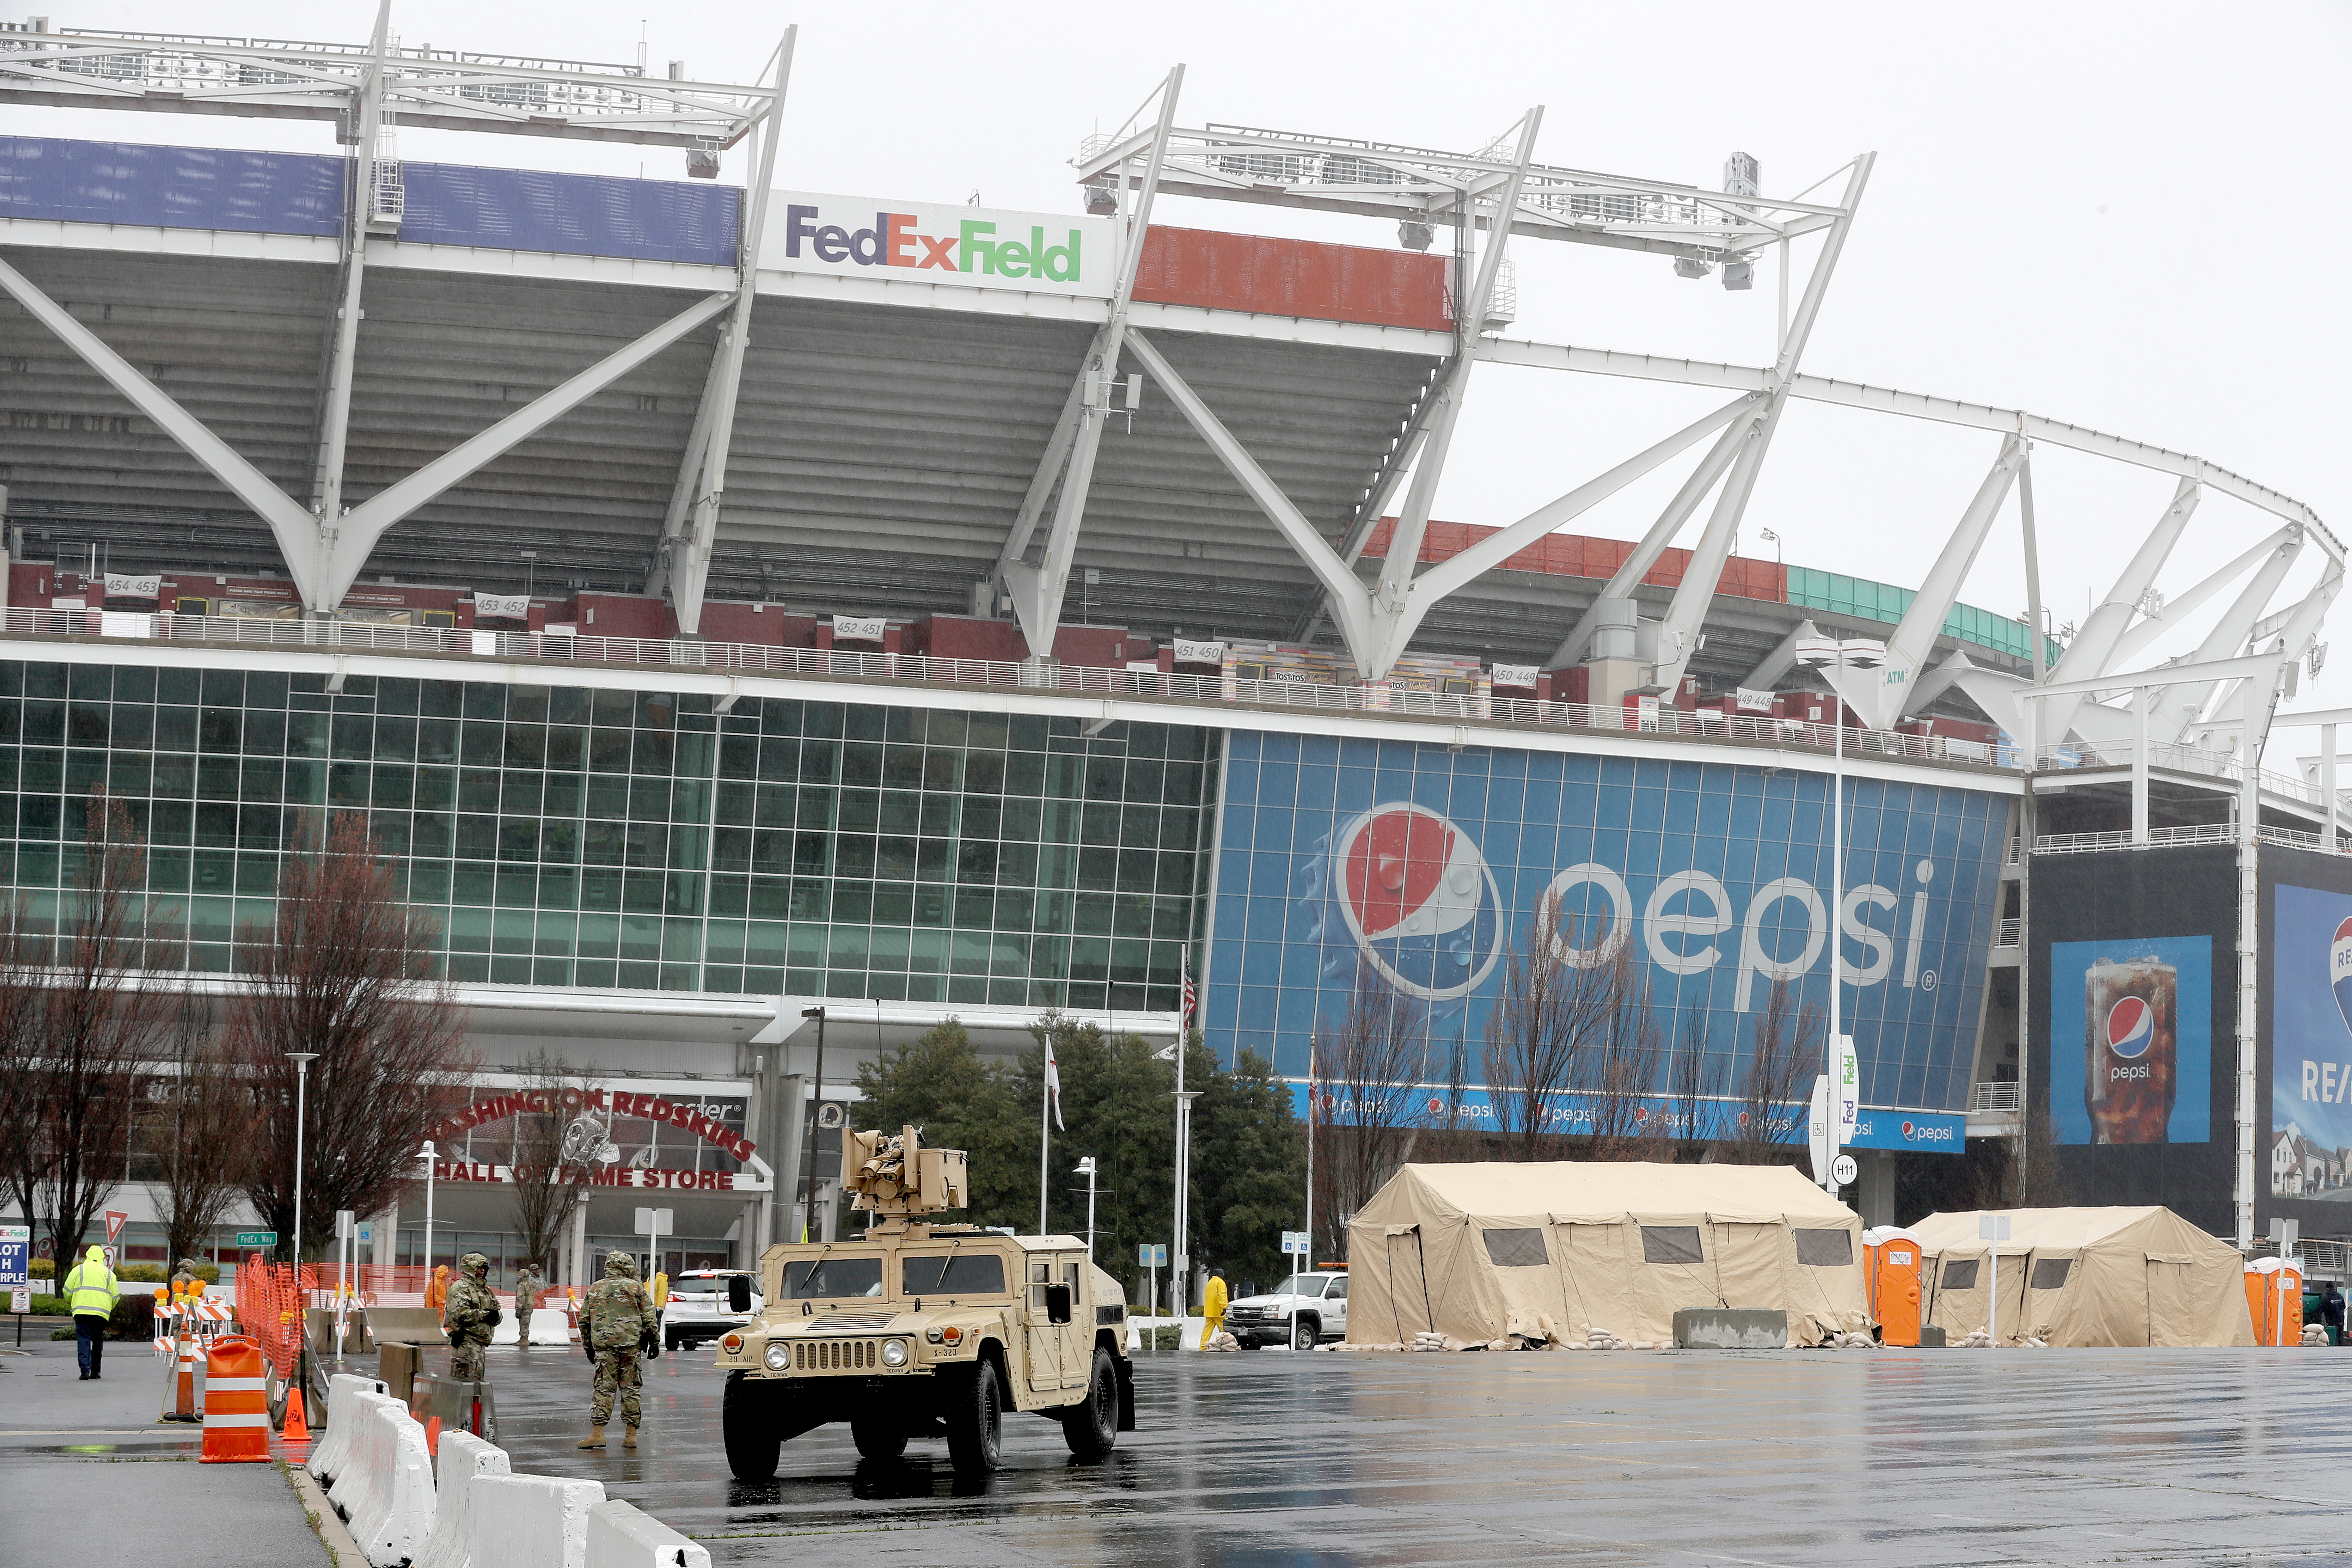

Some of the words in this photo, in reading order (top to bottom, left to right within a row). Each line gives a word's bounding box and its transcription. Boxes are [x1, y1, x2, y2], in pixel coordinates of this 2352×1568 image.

[786, 204, 1081, 282] FedExField
[107, 580, 129, 591] 454
[135, 582, 157, 592] 453
[478, 600, 499, 611] 453
[503, 601, 525, 612] 452
[837, 622, 858, 633] 452
[862, 623, 881, 634] 451
[1176, 645, 1194, 656] 451
[1199, 646, 1219, 658] 450
[1306, 674, 1329, 683] Nachos
[1494, 670, 1513, 680] 450
[1516, 671, 1536, 682] 449
[1887, 670, 1904, 684] ATM
[1406, 681, 1428, 690] Nachos
[1737, 693, 1752, 704] 449
[1755, 696, 1772, 707] 448
[2111, 1063, 2149, 1082] pepsi
[2302, 1060, 2352, 1105] RE/
[1553, 1107, 1596, 1124] pepsi
[421, 1087, 603, 1143] ASHINGTON
[612, 1090, 756, 1162] REDSKINS
[1853, 1121, 1873, 1138] psi
[1917, 1126, 1953, 1142] pepsi
[433, 1161, 502, 1182] HALL
[559, 1165, 633, 1186] FAME
[643, 1168, 733, 1190] STORE
[1838, 1164, 1853, 1176] H11
[0, 1229, 27, 1237] ExField
[241, 1235, 257, 1243] FedEx
[261, 1235, 273, 1244] Way
[2, 1259, 12, 1269] H
[0, 1272, 25, 1283] RPLE
[934, 1349, 957, 1357] X-323
